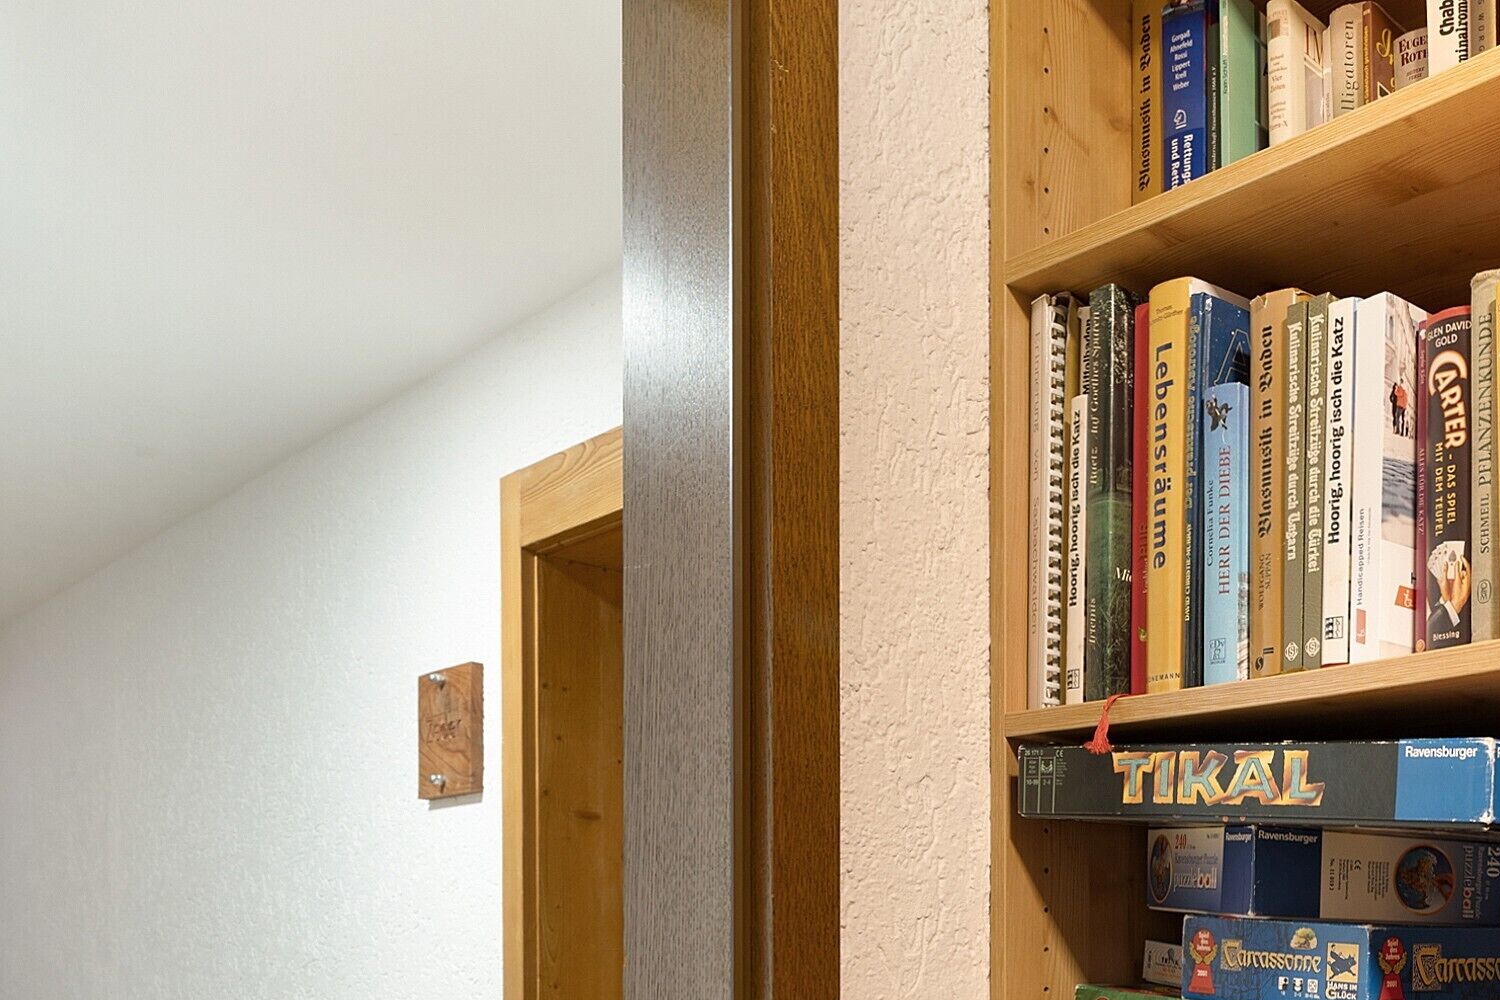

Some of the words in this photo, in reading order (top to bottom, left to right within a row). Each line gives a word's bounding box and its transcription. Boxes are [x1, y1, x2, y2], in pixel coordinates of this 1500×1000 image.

[1140, 15, 1150, 71] Baden
[1140, 75, 1150, 94] in
[1172, 80, 1190, 92] Weber
[1138, 98, 1150, 192] Blasmusik
[1257, 324, 1273, 391] Baden
[1331, 316, 1344, 358] Katz
[1435, 334, 1458, 347] GOLD
[1330, 360, 1343, 384] die
[1259, 398, 1273, 418] in
[1330, 386, 1342, 423] isch
[1428, 350, 1467, 449] CARTER
[1478, 312, 1492, 486] PFLANZENKUNDE
[1153, 341, 1173, 570] Lebensräume
[1218, 446, 1231, 497] DIEBE
[1329, 426, 1344, 481] hoorig
[1447, 464, 1456, 488] DAS
[1257, 426, 1274, 538] Blasmusik
[1218, 503, 1231, 539] DER
[1328, 482, 1343, 545] Hoorig,
[1447, 493, 1456, 525] SPIEL
[1479, 493, 1490, 554] SCHMEIL
[1218, 545, 1231, 595] HERR
[1405, 744, 1478, 760] Ravensburger
[1112, 750, 1325, 807] TIKAL
[1257, 828, 1319, 845] Ravensburger
[1221, 940, 1321, 972] Carcassonne
